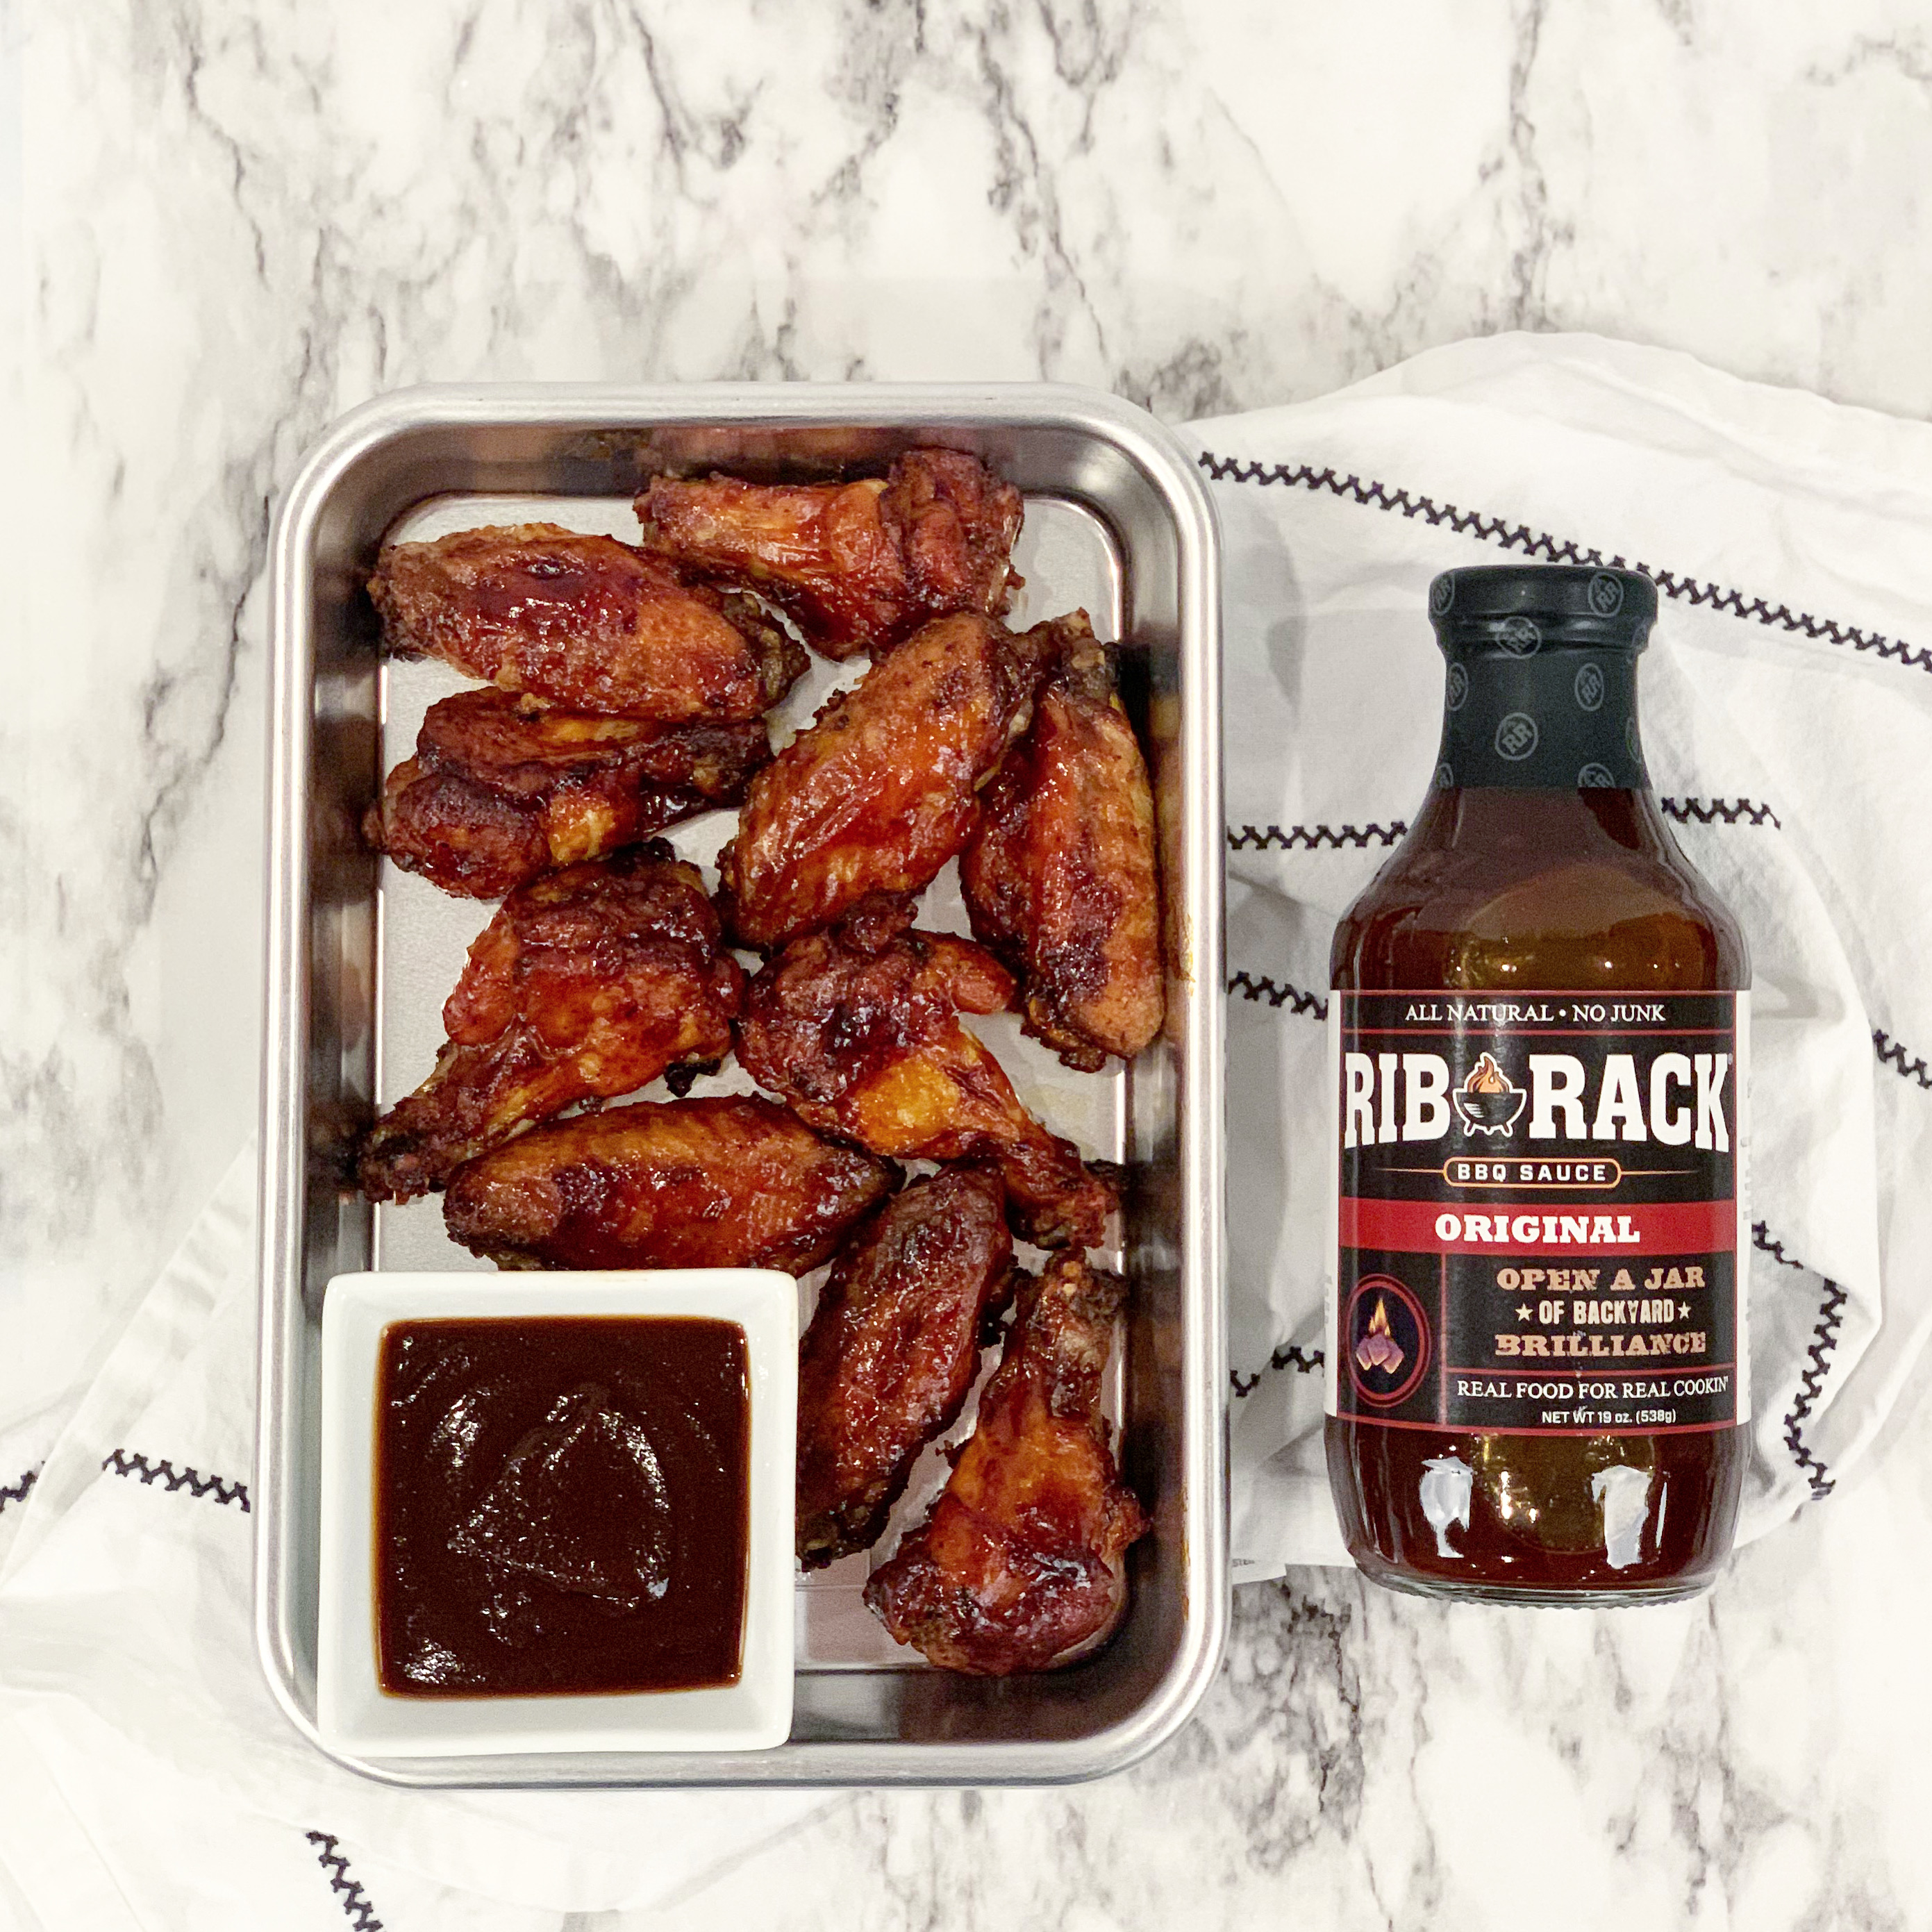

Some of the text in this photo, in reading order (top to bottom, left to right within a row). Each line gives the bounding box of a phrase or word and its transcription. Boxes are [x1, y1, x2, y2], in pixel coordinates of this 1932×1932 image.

[1405, 1004, 1666, 1022] ALL NATURAL NO JUNK
[1344, 1053, 1729, 1153] RIB RACK
[1458, 1165, 1606, 1183] BBQ SAUCE
[1435, 1213, 1640, 1244] ORIGINAL
[1497, 1266, 1706, 1291] OPEN A JAR
[1539, 1299, 1675, 1325] OF BACKYARD
[1494, 1332, 1706, 1357] BRILLIANCE
[1458, 1380, 1513, 1399] REAL
[1517, 1382, 1574, 1399] FOOD
[1579, 1381, 1619, 1399] FOR
[1622, 1381, 1671, 1399] REAL
[1542, 1408, 1676, 1424] NET WT 19 oz. (538g)
